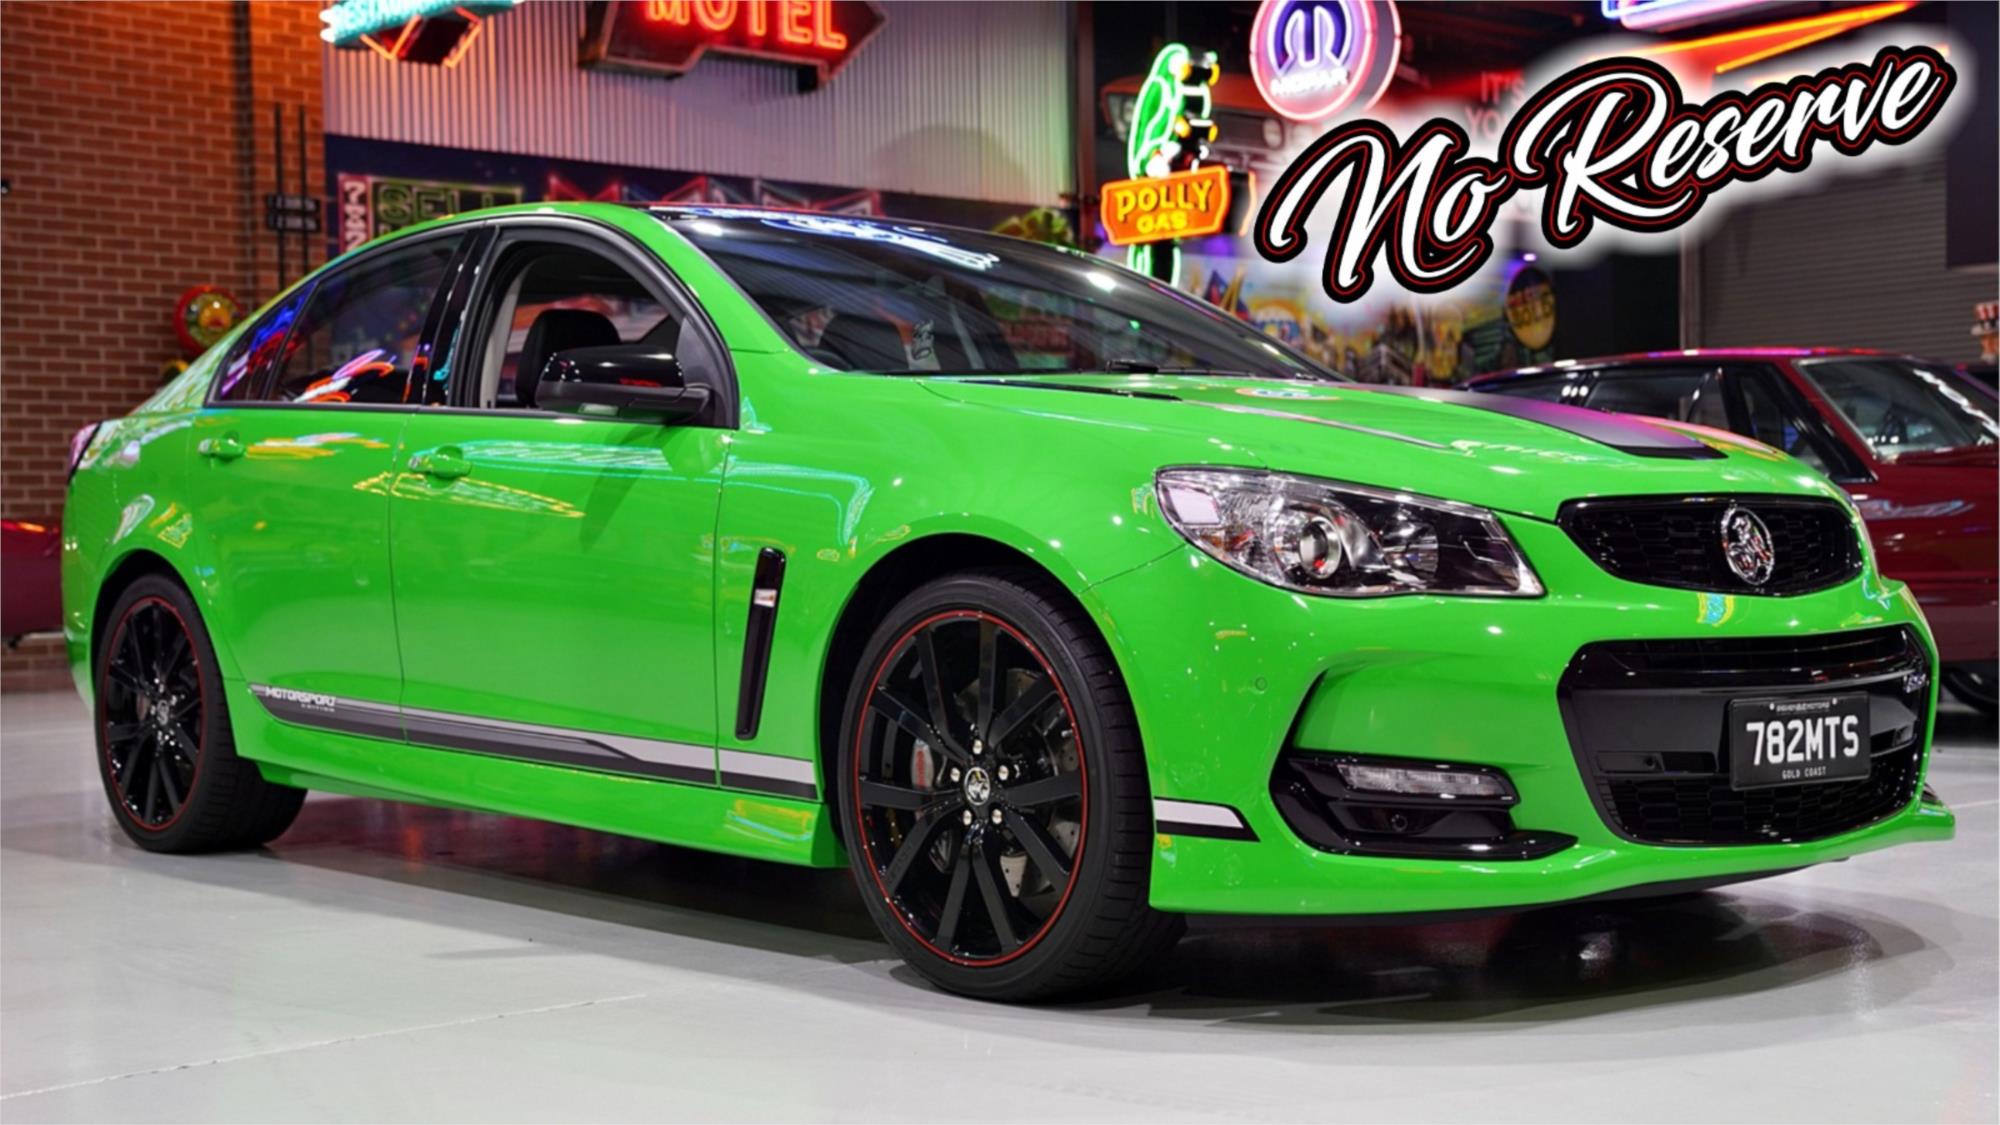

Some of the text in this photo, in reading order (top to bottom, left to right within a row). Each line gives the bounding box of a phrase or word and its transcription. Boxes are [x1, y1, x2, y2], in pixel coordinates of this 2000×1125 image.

[1464, 106, 1509, 139] YO
[1115, 178, 1213, 222] POLLY
[1136, 210, 1187, 234] GAS
[265, 687, 337, 707] MOTORSPORT
[1746, 715, 1859, 766] 782MTS
[1782, 766, 1827, 780] GOLD COAST
